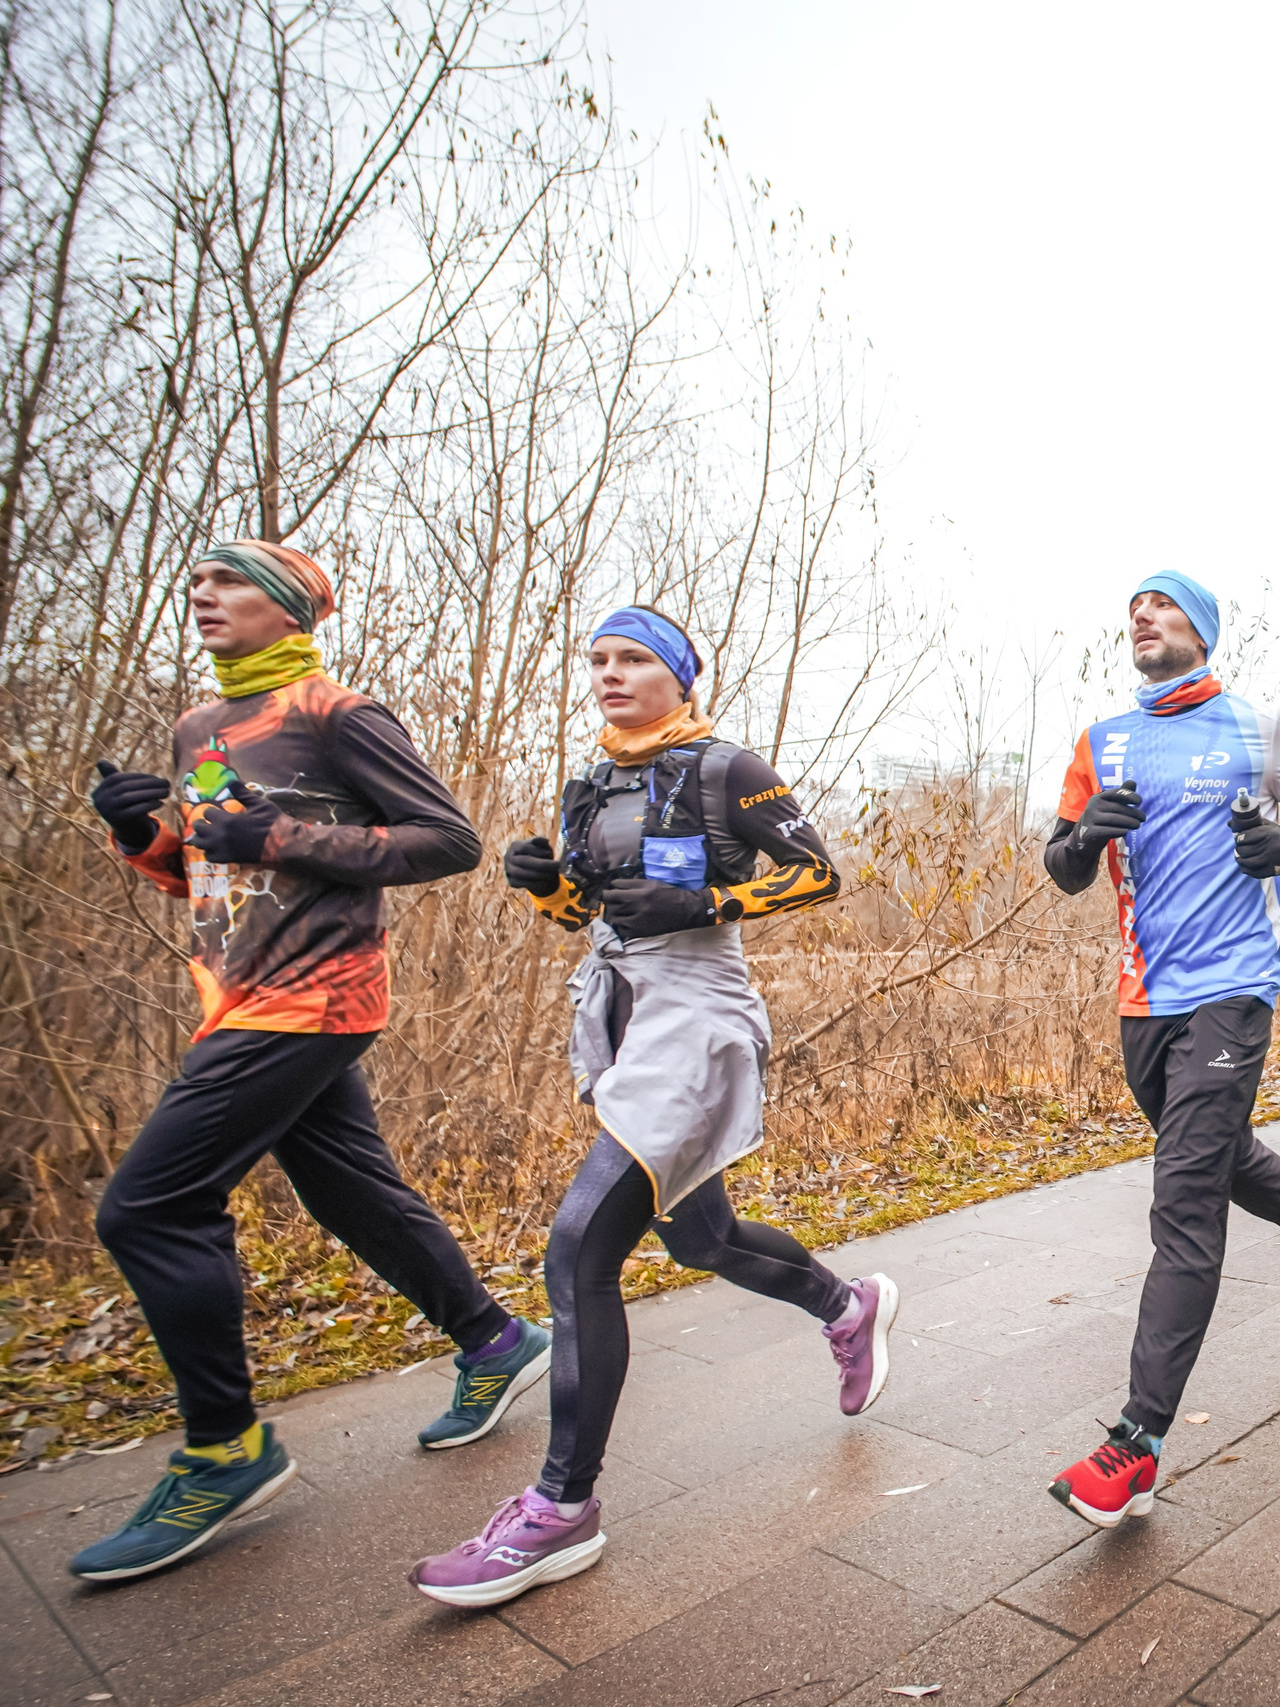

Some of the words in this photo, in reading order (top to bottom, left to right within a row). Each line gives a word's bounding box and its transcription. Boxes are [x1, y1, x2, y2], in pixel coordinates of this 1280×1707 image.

[1184, 776, 1230, 791] Veynov
[739, 788, 775, 810] Crazy
[1181, 791, 1228, 807] Dmitriy
[1207, 1061, 1236, 1069] DEMIX
